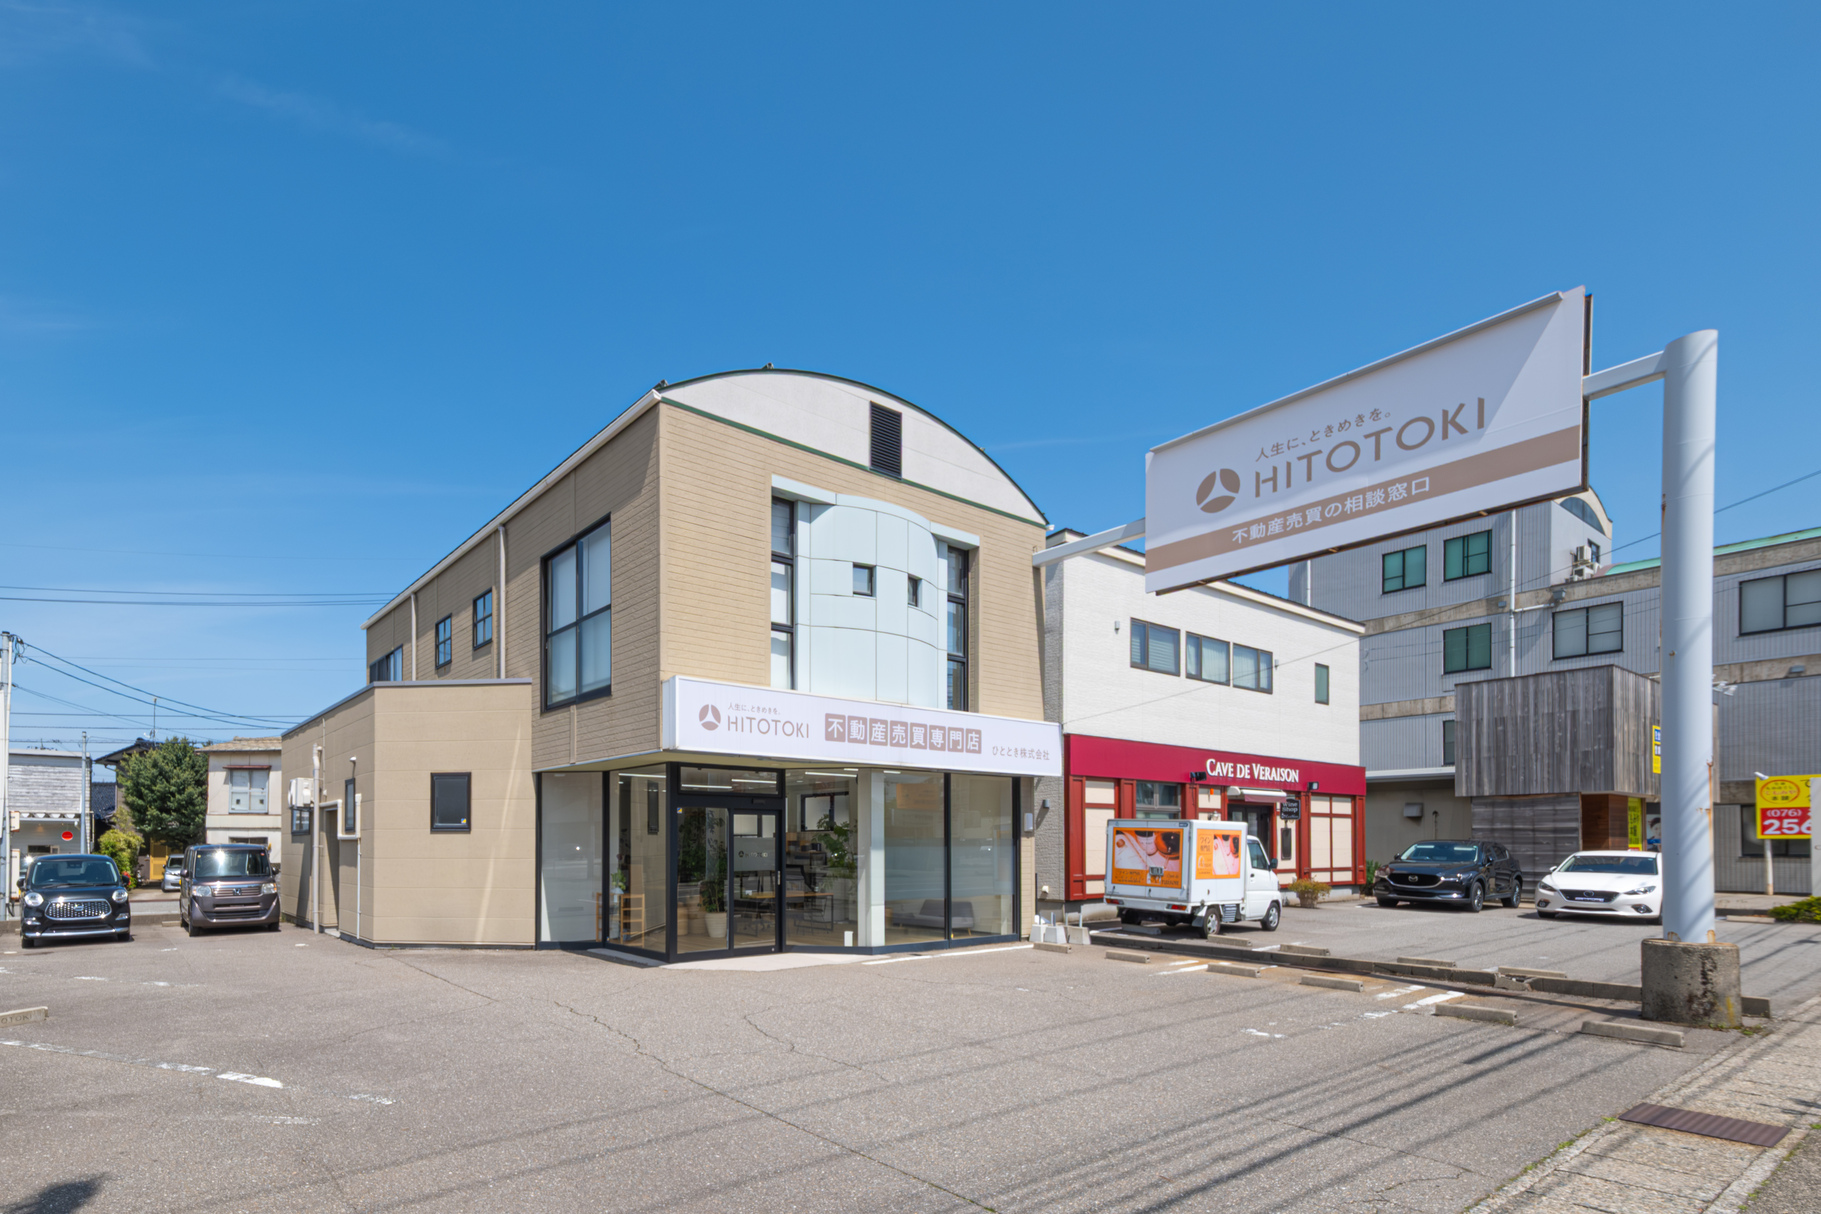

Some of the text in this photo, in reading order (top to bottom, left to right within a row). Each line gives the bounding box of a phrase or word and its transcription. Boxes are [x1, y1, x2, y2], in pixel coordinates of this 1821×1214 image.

[1255, 407, 1391, 462] 人生に、ときめきを。
[1255, 397, 1485, 498] HITOTOKI
[1232, 476, 1430, 544] 不動産売買の相談窓口
[727, 702, 781, 715] 人生に、ときめきを。
[727, 715, 809, 739] HITOTOKI
[827, 718, 980, 752] 不動産売買専門店
[992, 746, 1050, 761] ひととき株式会社
[1206, 758, 1299, 783] CAVE DE VERAISON
[1766, 808, 1802, 817] (076)
